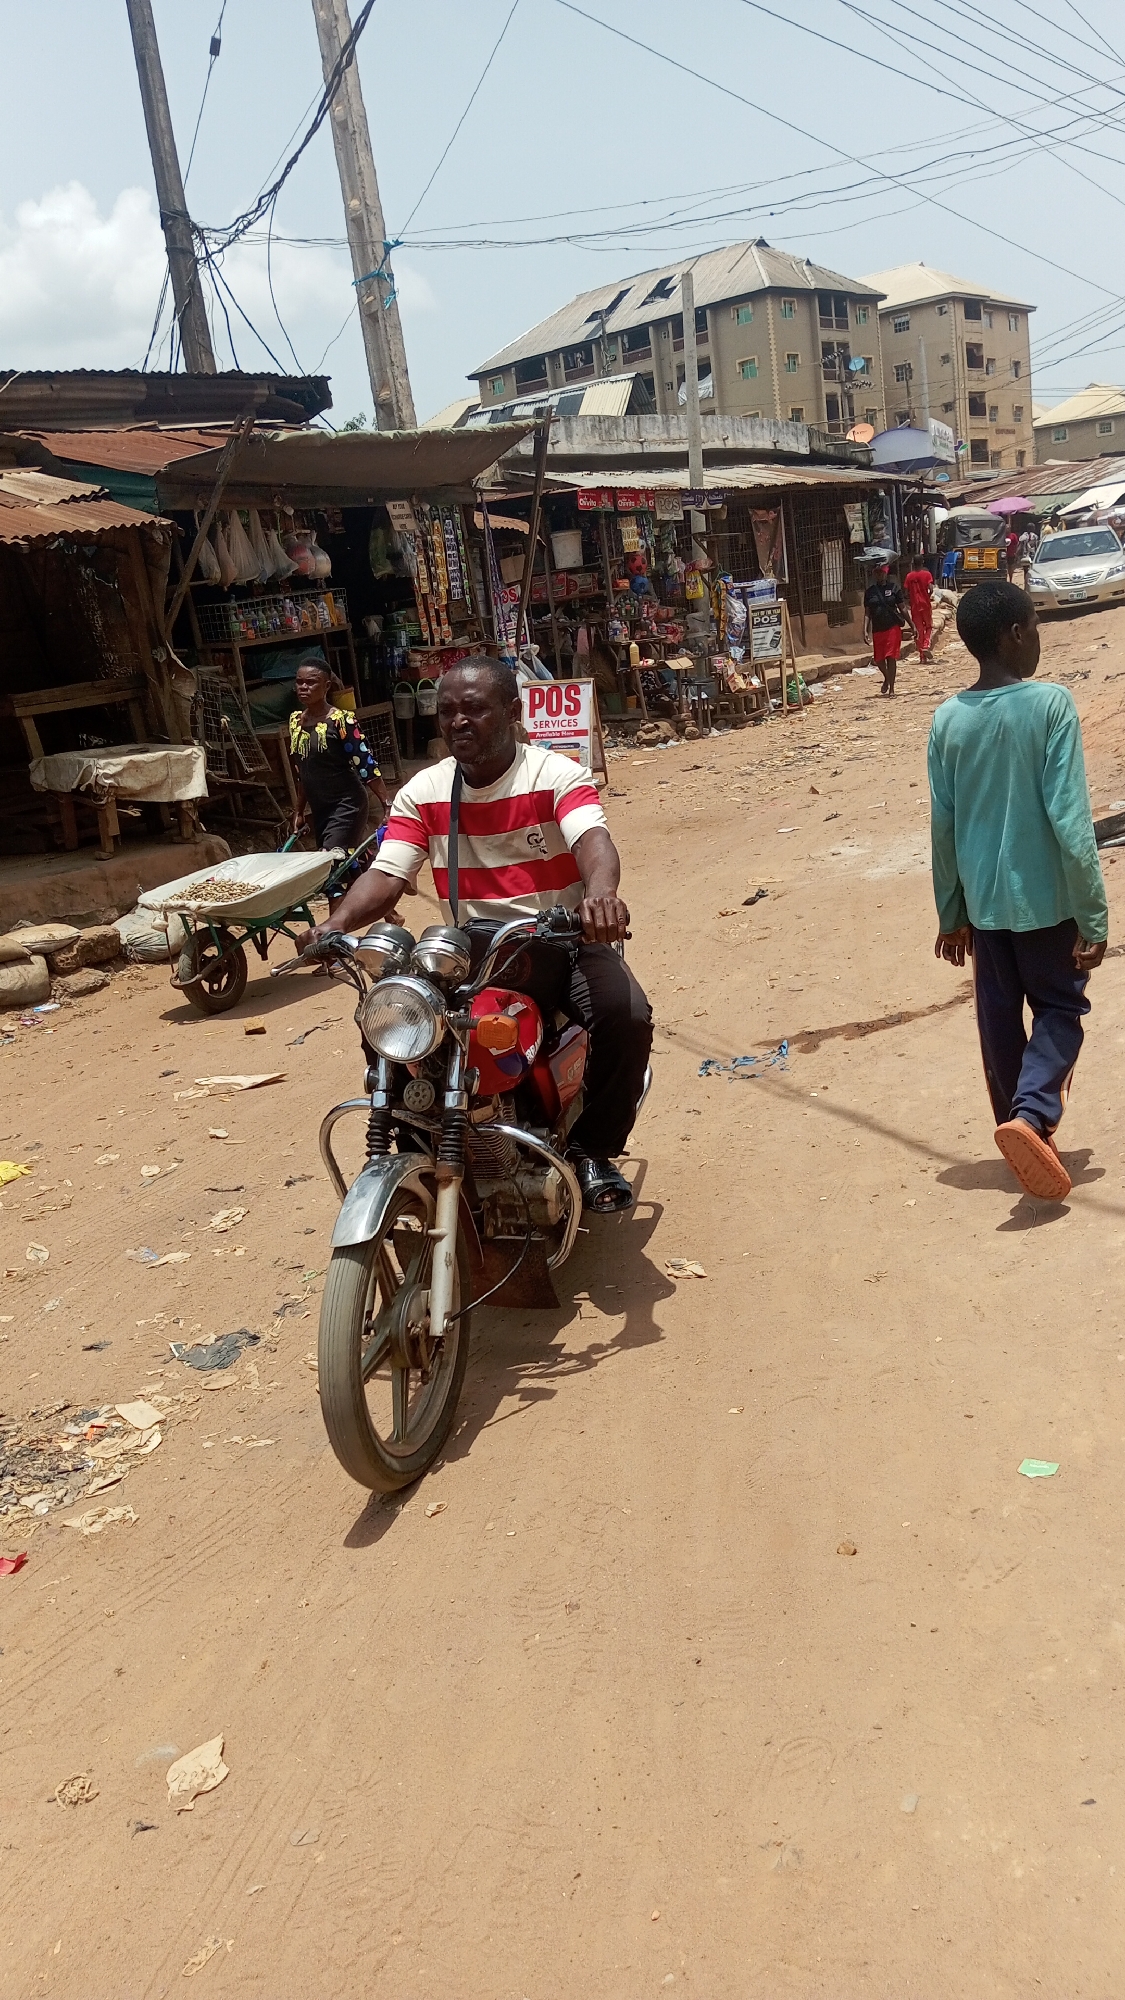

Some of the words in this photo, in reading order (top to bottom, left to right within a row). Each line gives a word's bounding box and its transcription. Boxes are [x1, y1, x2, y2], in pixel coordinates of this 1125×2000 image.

[658, 497, 680, 511] POS
[753, 614, 778, 625] POS
[528, 683, 581, 718] POS
[533, 718, 578, 729] SERVICES
